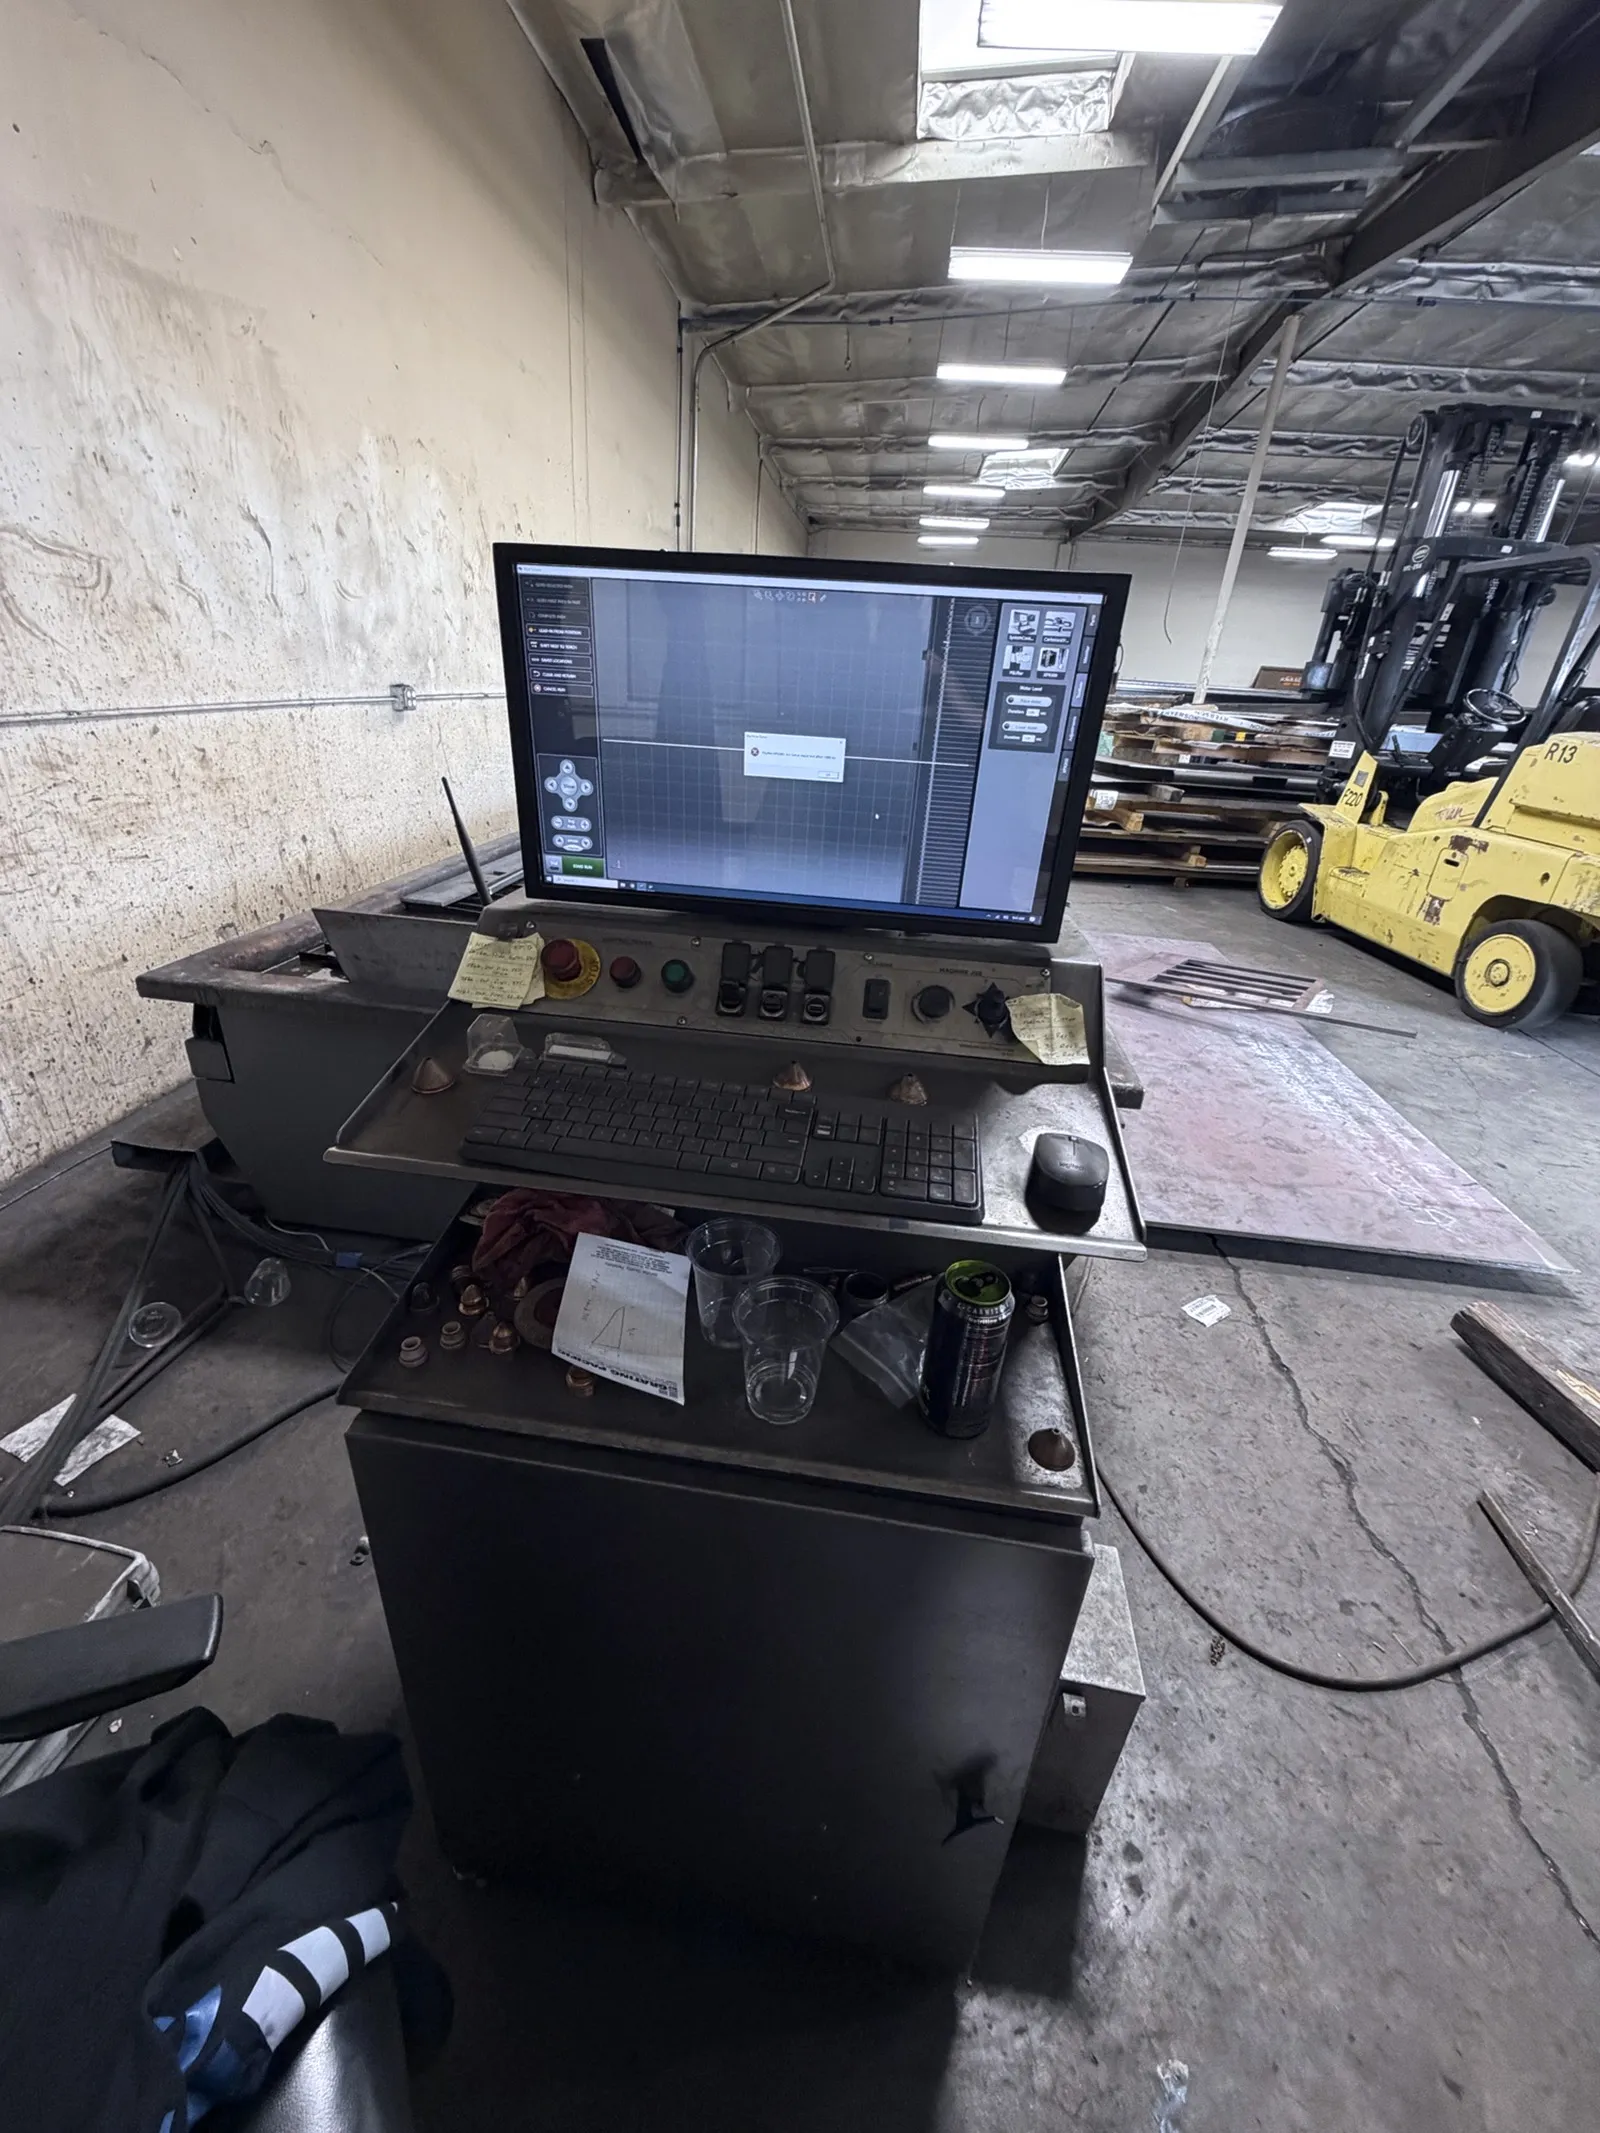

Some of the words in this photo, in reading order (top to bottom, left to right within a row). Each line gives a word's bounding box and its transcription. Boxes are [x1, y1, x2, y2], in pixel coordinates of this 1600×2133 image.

[1544, 743, 1578, 764] R13
[1341, 788, 1364, 808] F220
[610, 1369, 668, 1391] GRATING
